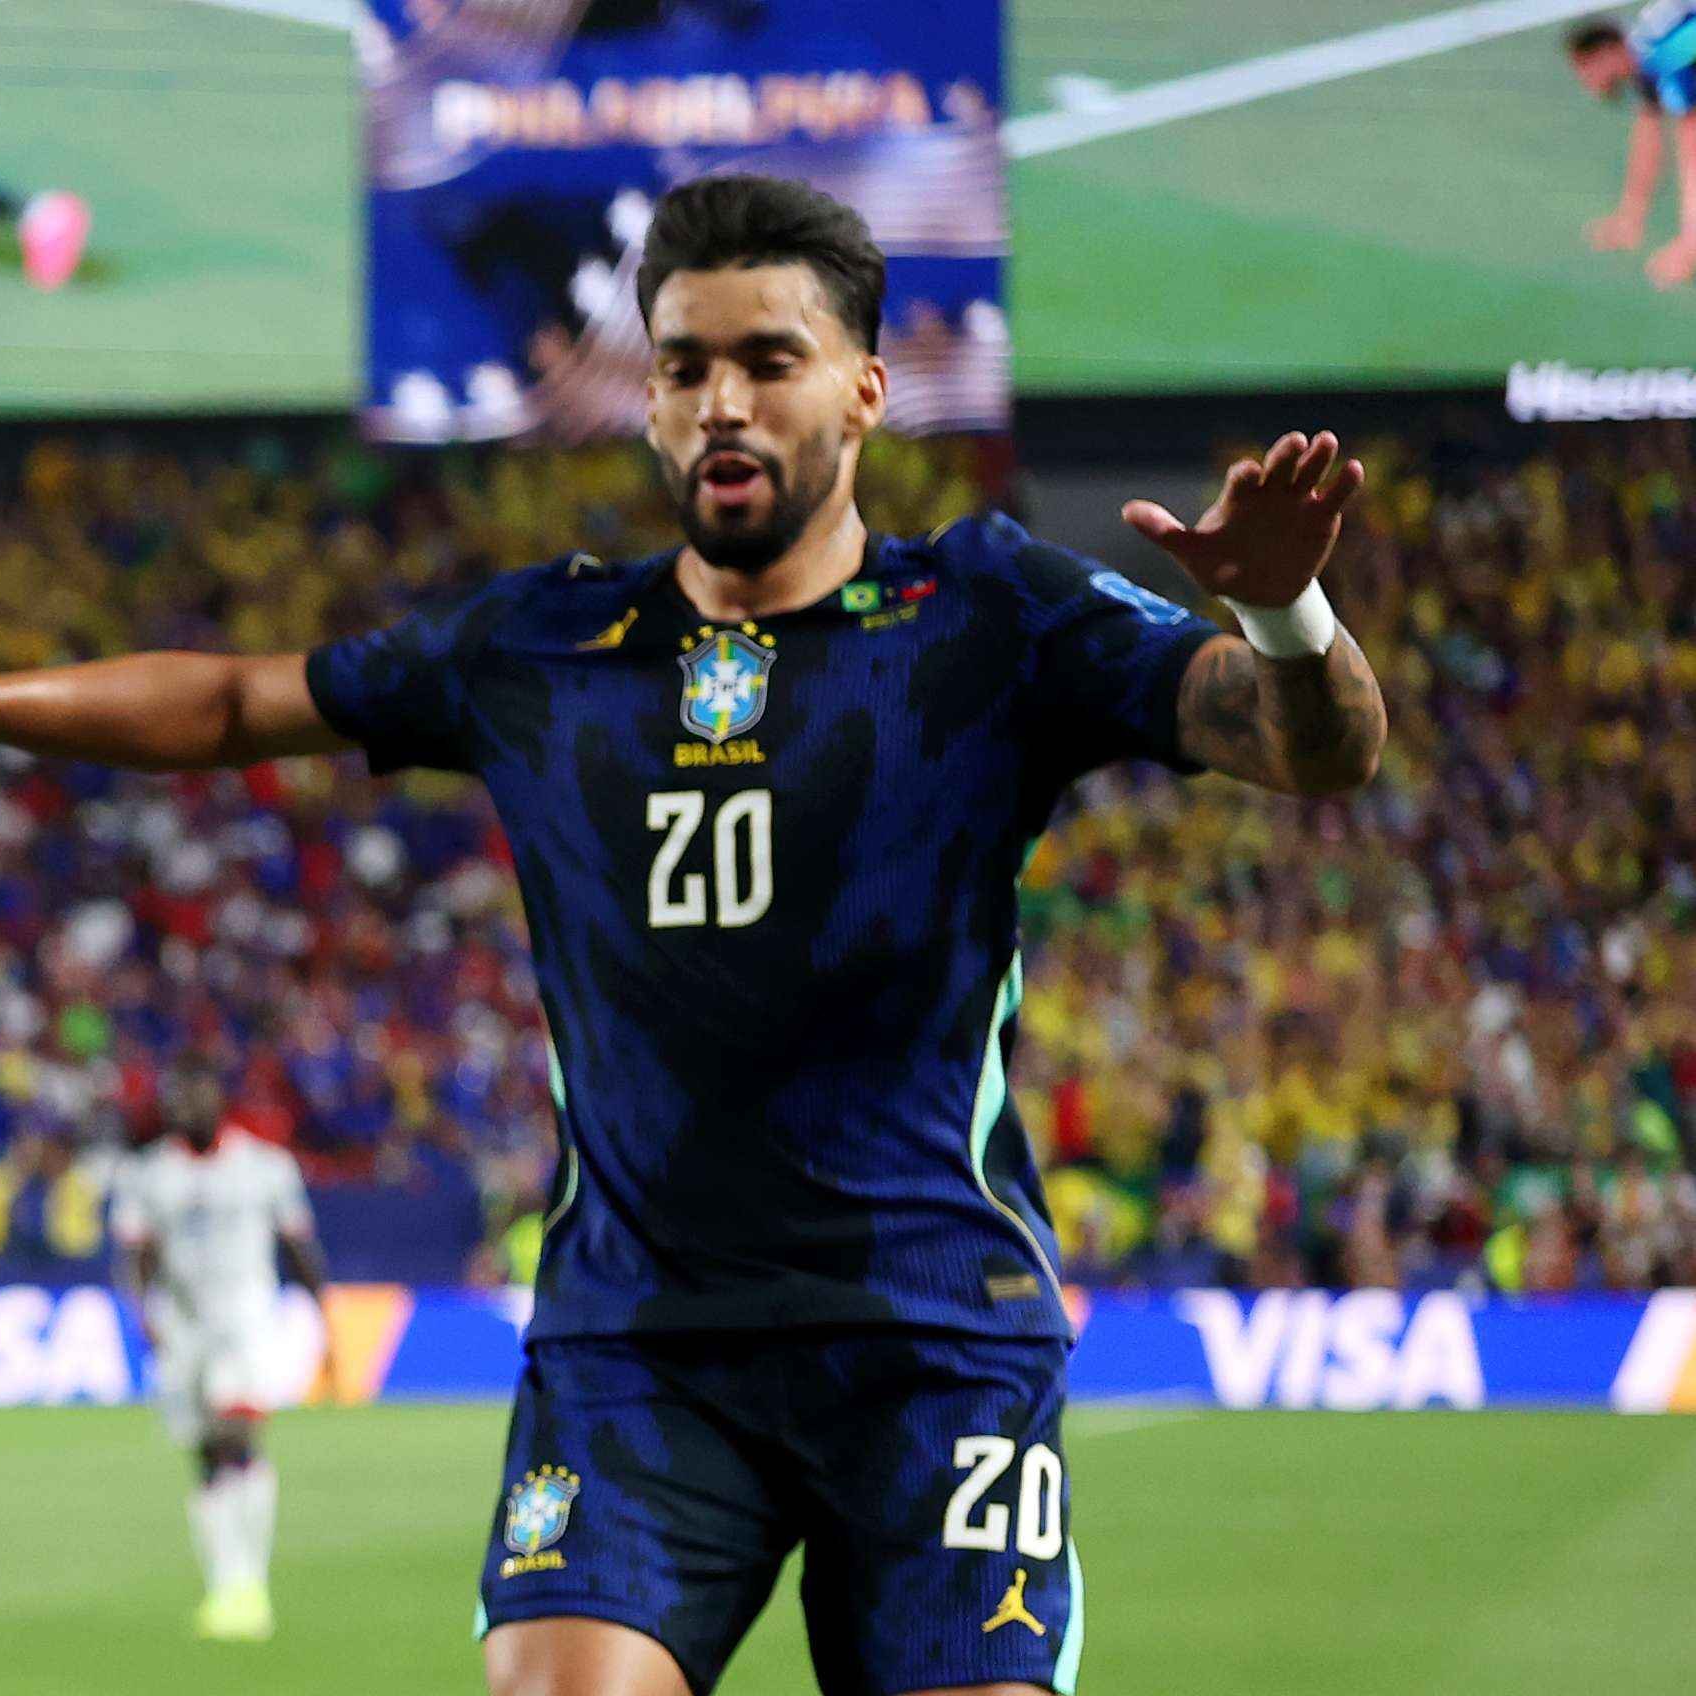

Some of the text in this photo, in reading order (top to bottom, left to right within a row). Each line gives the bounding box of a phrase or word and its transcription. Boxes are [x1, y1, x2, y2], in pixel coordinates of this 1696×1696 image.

[673, 740, 766, 767] BRASIL
[646, 788, 774, 928] 20
[1175, 1288, 1487, 1408] VISA
[942, 1434, 1063, 1560] 20
